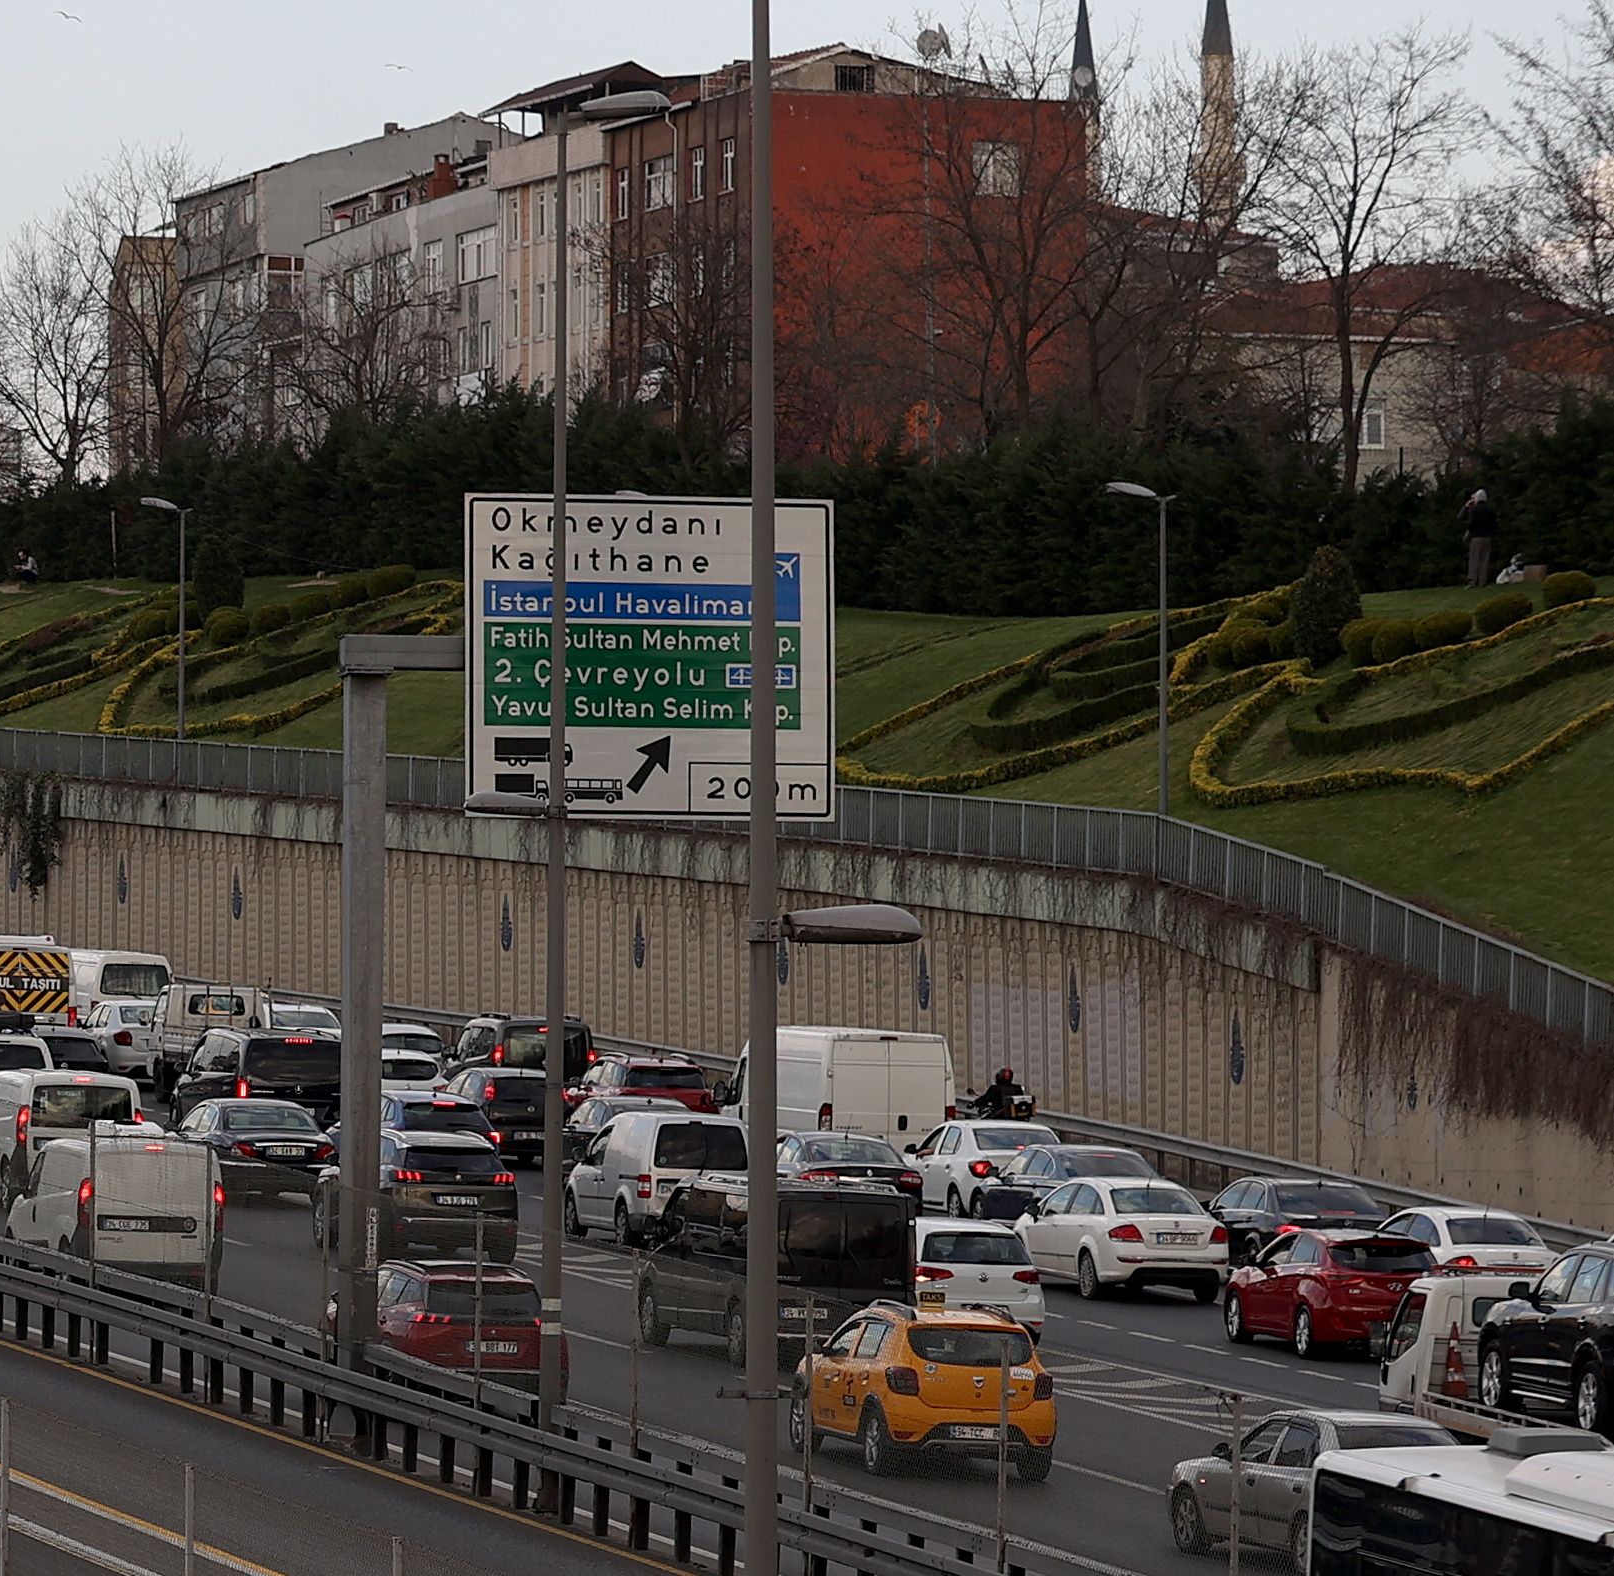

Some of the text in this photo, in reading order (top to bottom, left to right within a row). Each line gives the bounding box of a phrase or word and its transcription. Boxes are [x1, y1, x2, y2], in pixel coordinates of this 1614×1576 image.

[491, 506, 721, 541] Okmeydanı
[490, 626, 741, 652] Fatih Sultan Mehmet
[494, 658, 705, 692] 2. Çevreyolu
[490, 694, 556, 717] Yavu
[574, 695, 655, 718] Sultan
[663, 697, 733, 720] Selim
[706, 776, 780, 800] 20
[21, 977, 62, 992] TAŞITI
